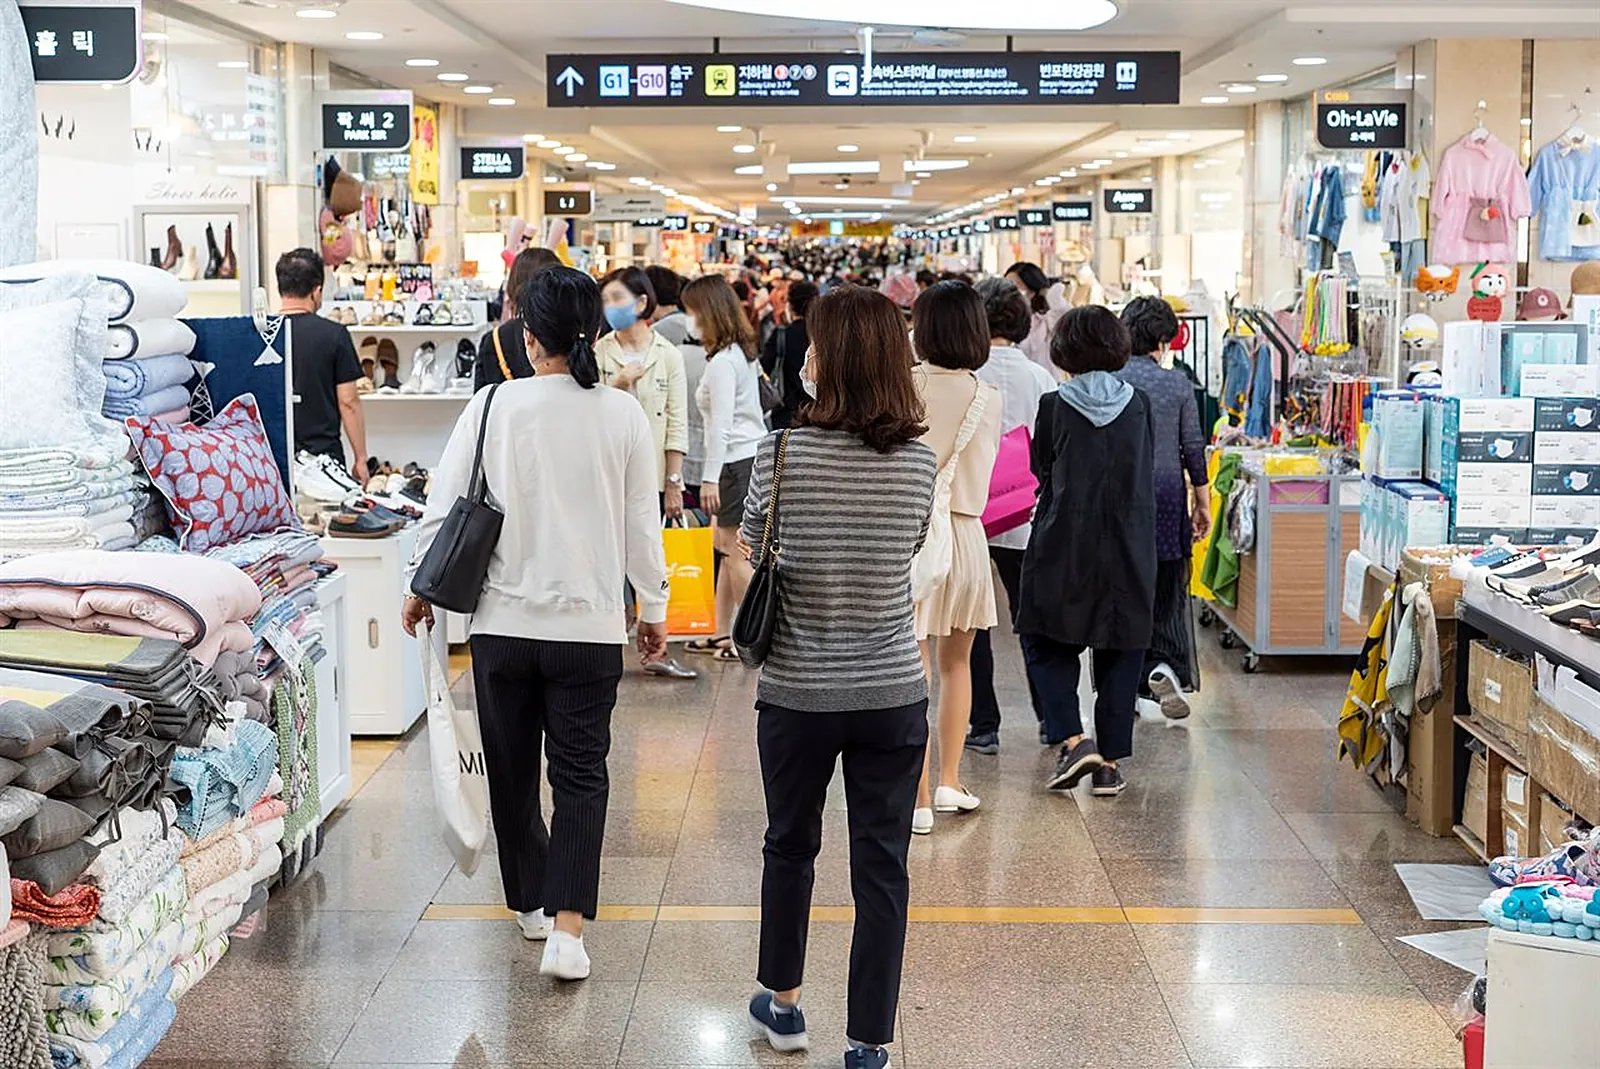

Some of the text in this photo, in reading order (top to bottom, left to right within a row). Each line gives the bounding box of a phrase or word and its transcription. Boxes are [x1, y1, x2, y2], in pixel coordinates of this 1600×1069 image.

[72, 30, 93, 56] 릭
[739, 65, 772, 80] 지하철
[1039, 63, 1105, 78] 반포한강공원
[604, 73, 664, 88] G1 G10
[382, 112, 395, 129] 2
[473, 153, 512, 166] STELLA
